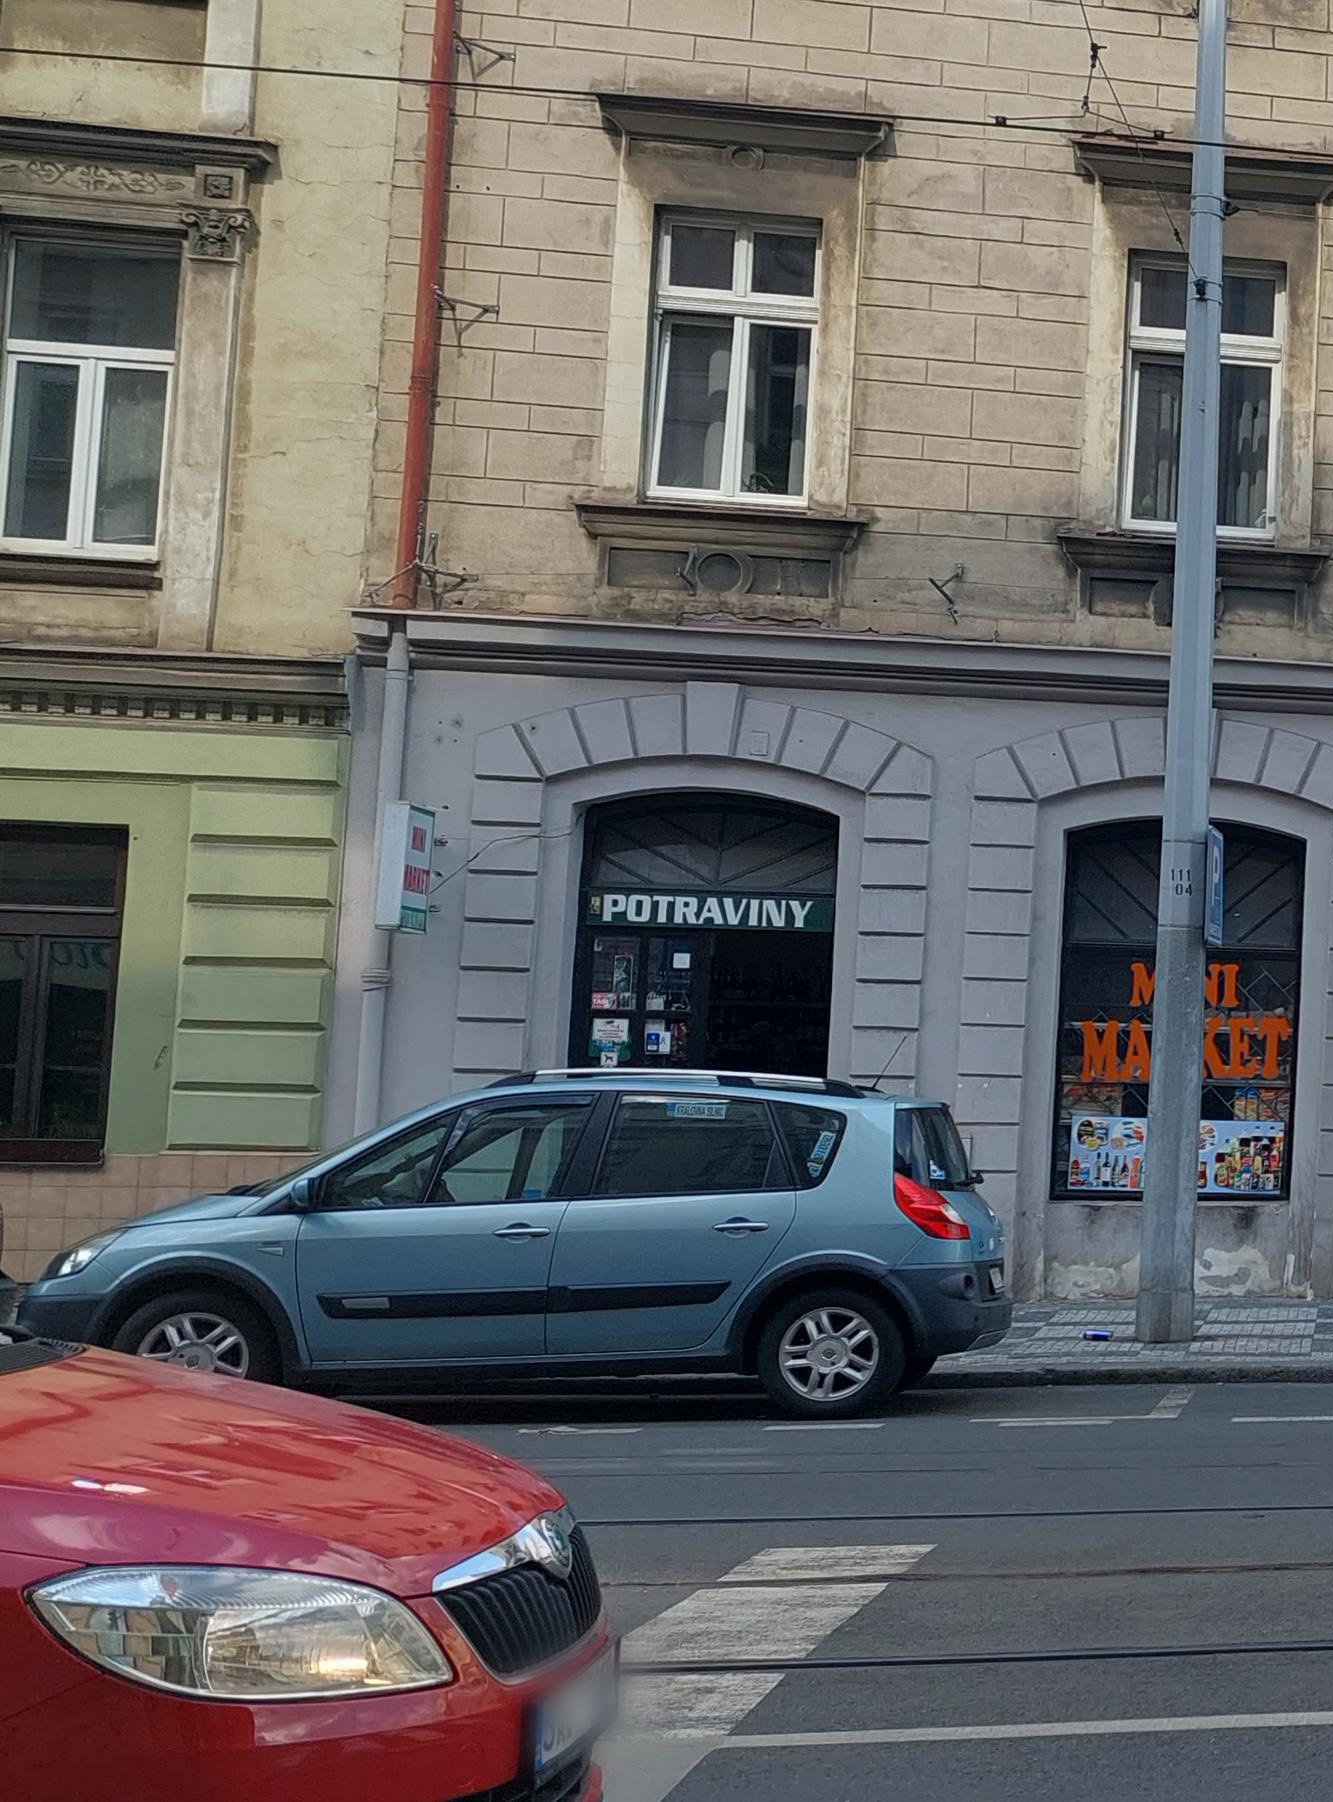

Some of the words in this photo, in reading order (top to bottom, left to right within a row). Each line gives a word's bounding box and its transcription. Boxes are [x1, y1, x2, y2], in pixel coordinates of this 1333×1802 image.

[1171, 869, 1191, 881] 111
[1175, 884, 1193, 896] 04
[602, 894, 814, 928] POTRAVINY
[1129, 961, 1241, 1008] MNI
[1081, 1016, 1289, 1082] MAKET
